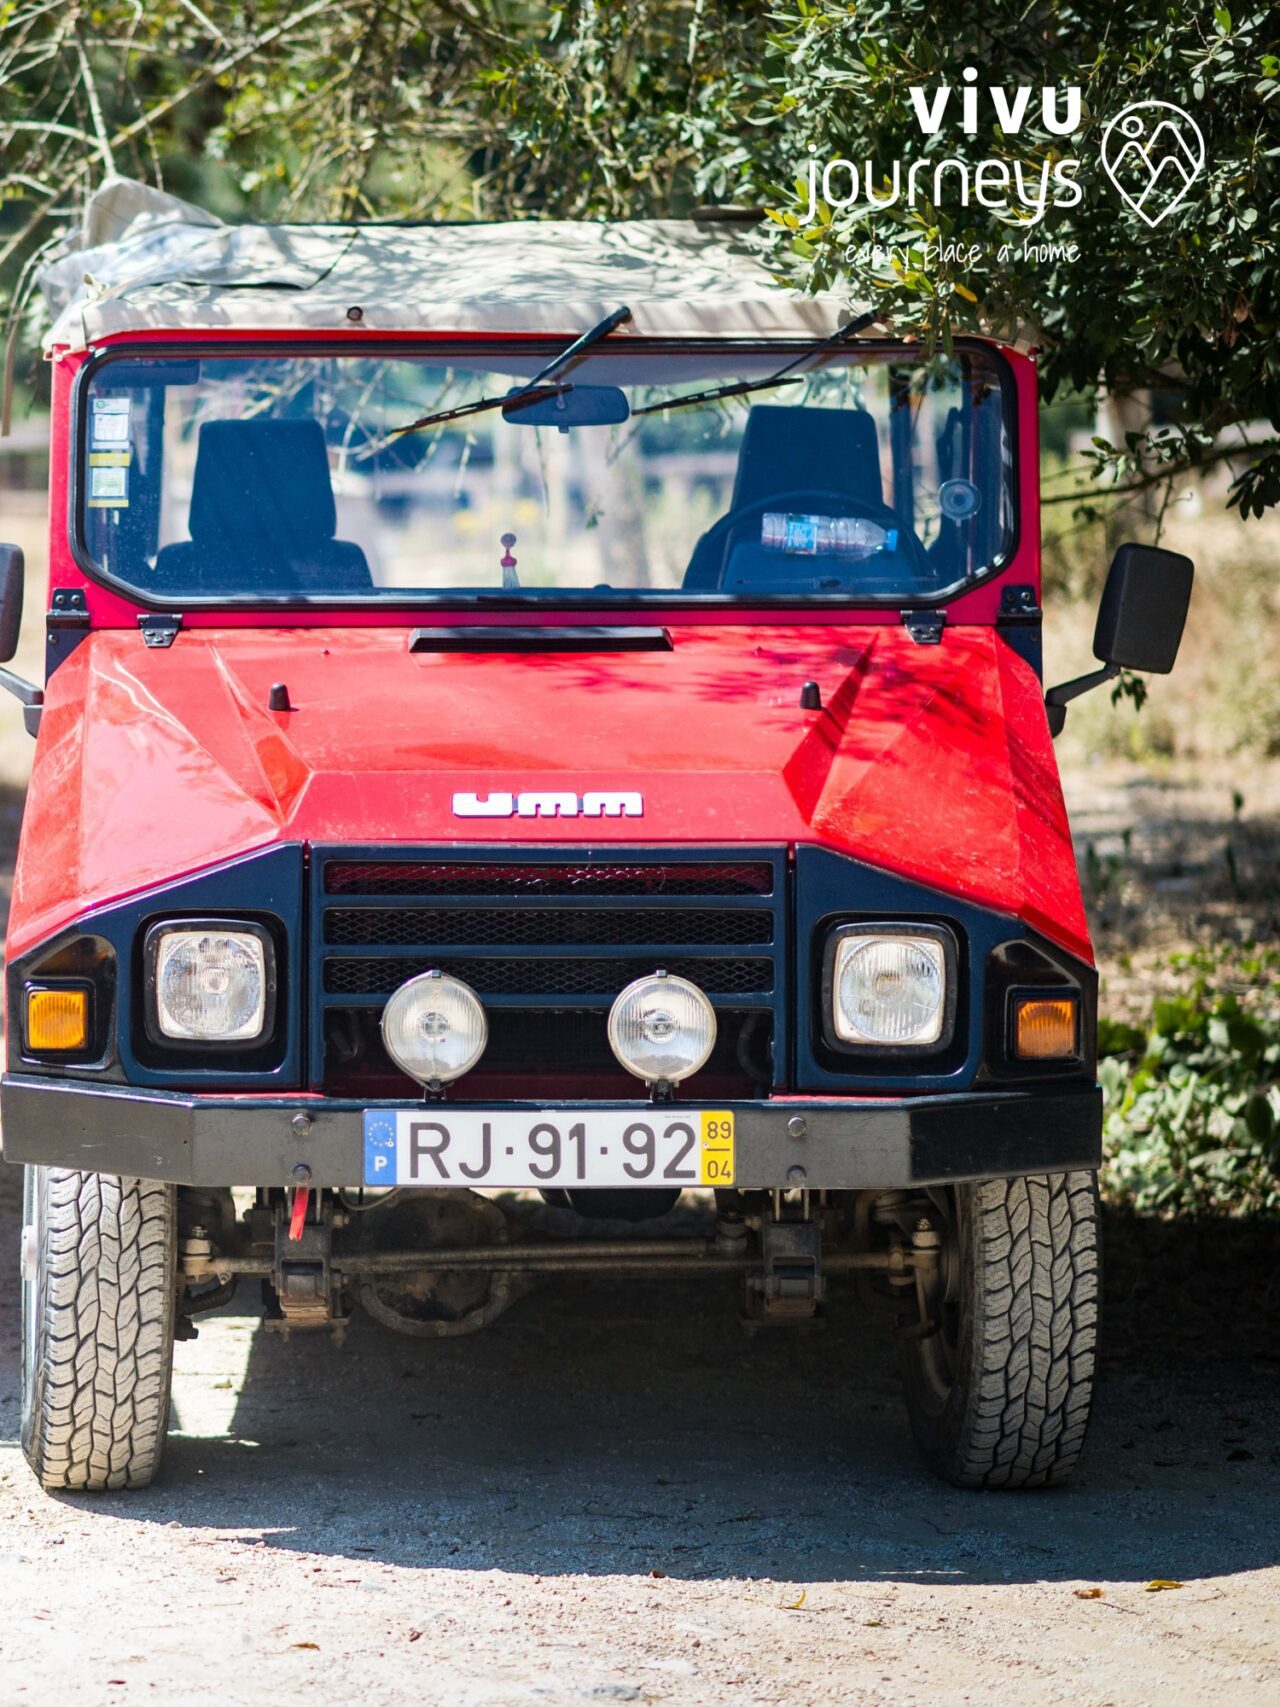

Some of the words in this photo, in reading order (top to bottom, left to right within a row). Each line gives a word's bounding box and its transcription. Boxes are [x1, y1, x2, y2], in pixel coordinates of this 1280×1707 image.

[707, 1121, 732, 1140] 89
[374, 1155, 388, 1173] P
[707, 1160, 732, 1179] 04
